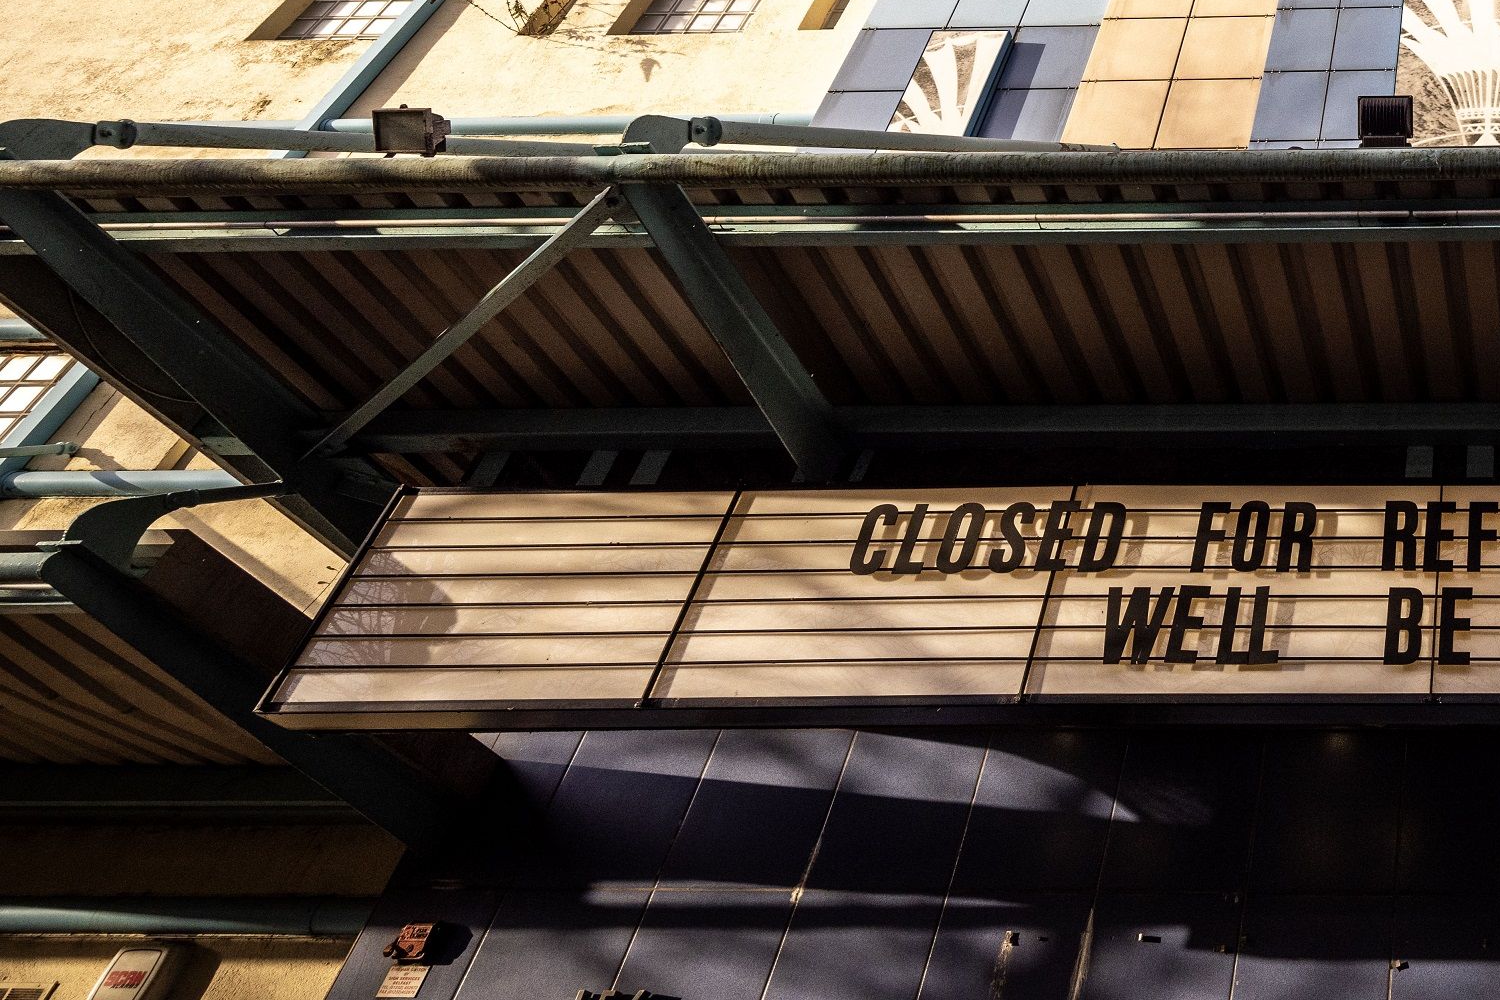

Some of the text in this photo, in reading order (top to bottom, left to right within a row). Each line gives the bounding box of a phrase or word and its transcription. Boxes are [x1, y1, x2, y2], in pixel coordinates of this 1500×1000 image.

[849, 500, 1127, 575] CLOSED
[1190, 500, 1317, 573] FOR
[1102, 585, 1279, 665] WELL
[1383, 586, 1473, 666] BE
